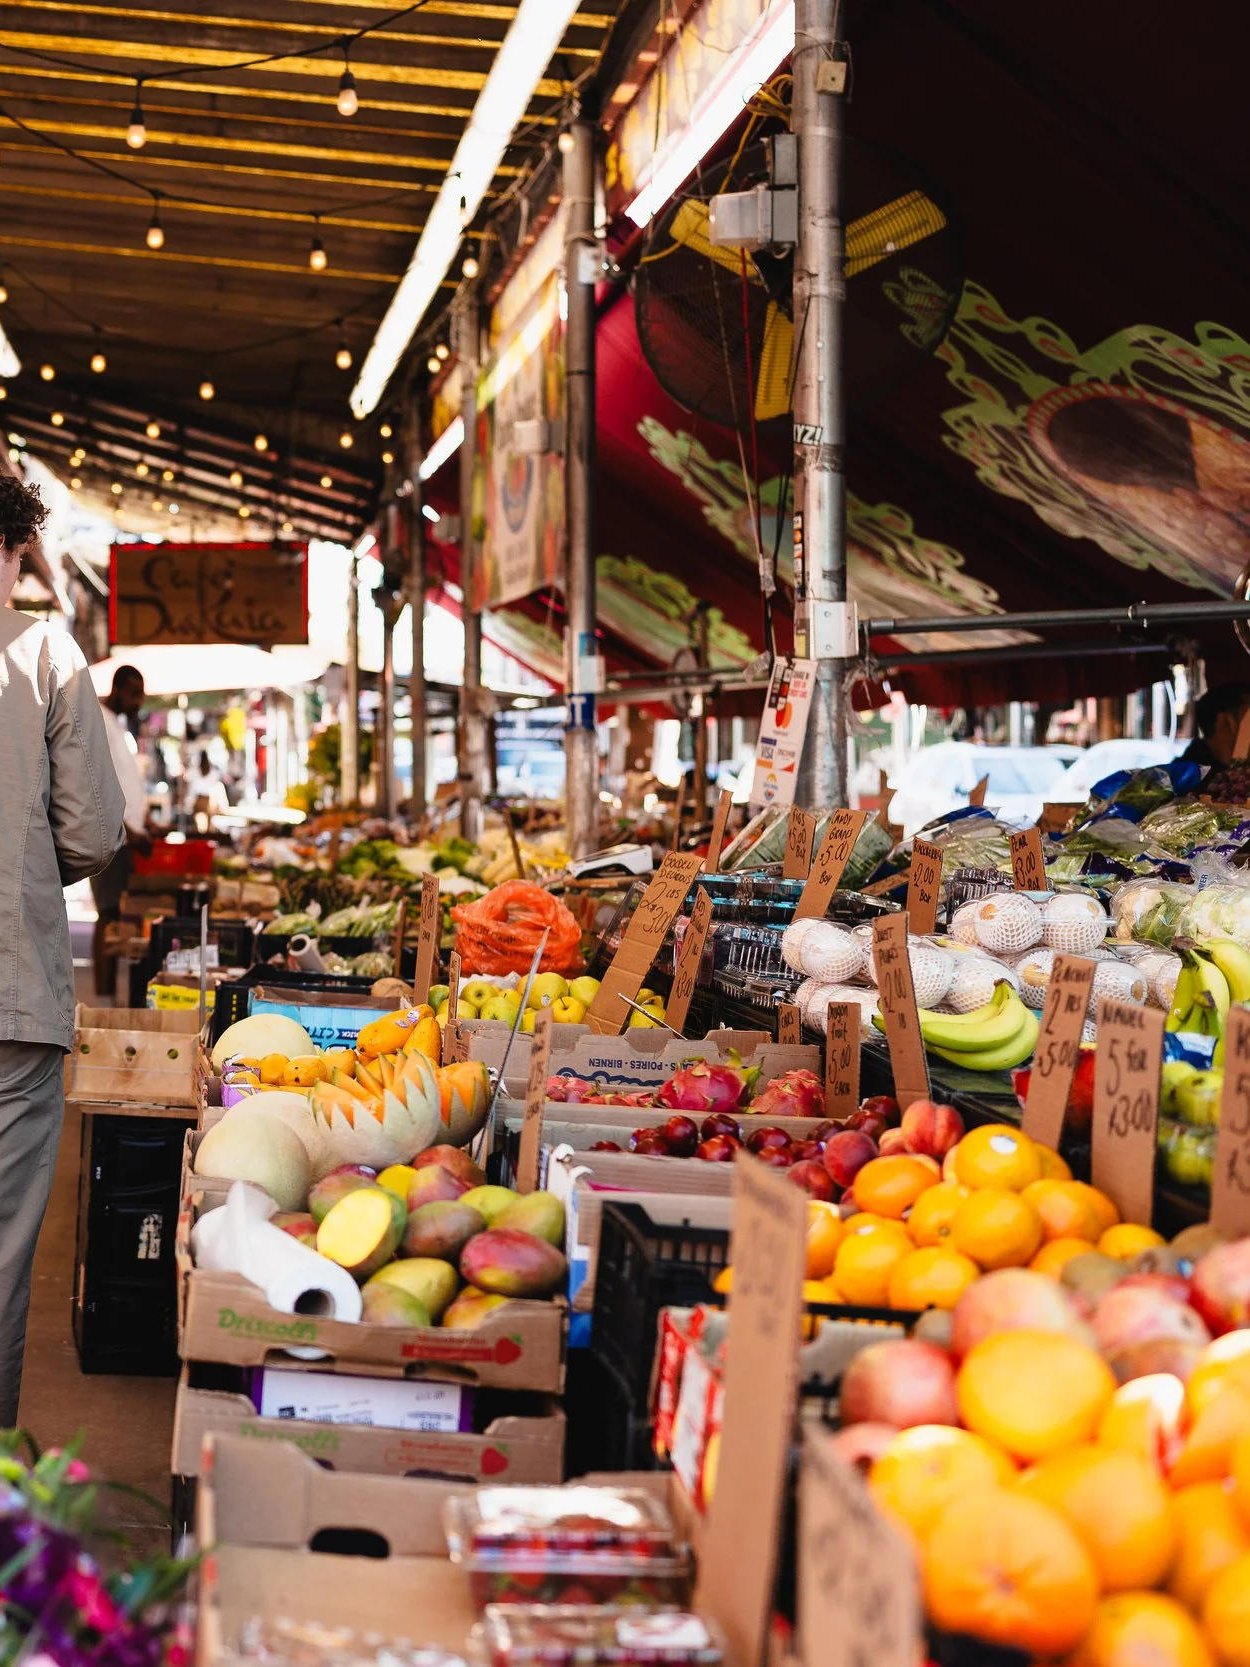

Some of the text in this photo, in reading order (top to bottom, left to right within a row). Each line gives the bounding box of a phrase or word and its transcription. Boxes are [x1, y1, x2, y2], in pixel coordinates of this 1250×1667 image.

[829, 826, 854, 841] GRAPES
[663, 851, 695, 870] GOLDEN
[639, 881, 668, 911] 2
[1044, 988, 1062, 1036] 2
[588, 1057, 623, 1069] BIRNEN
[629, 1059, 663, 1071] POIRES
[1106, 1038, 1121, 1097] 5
